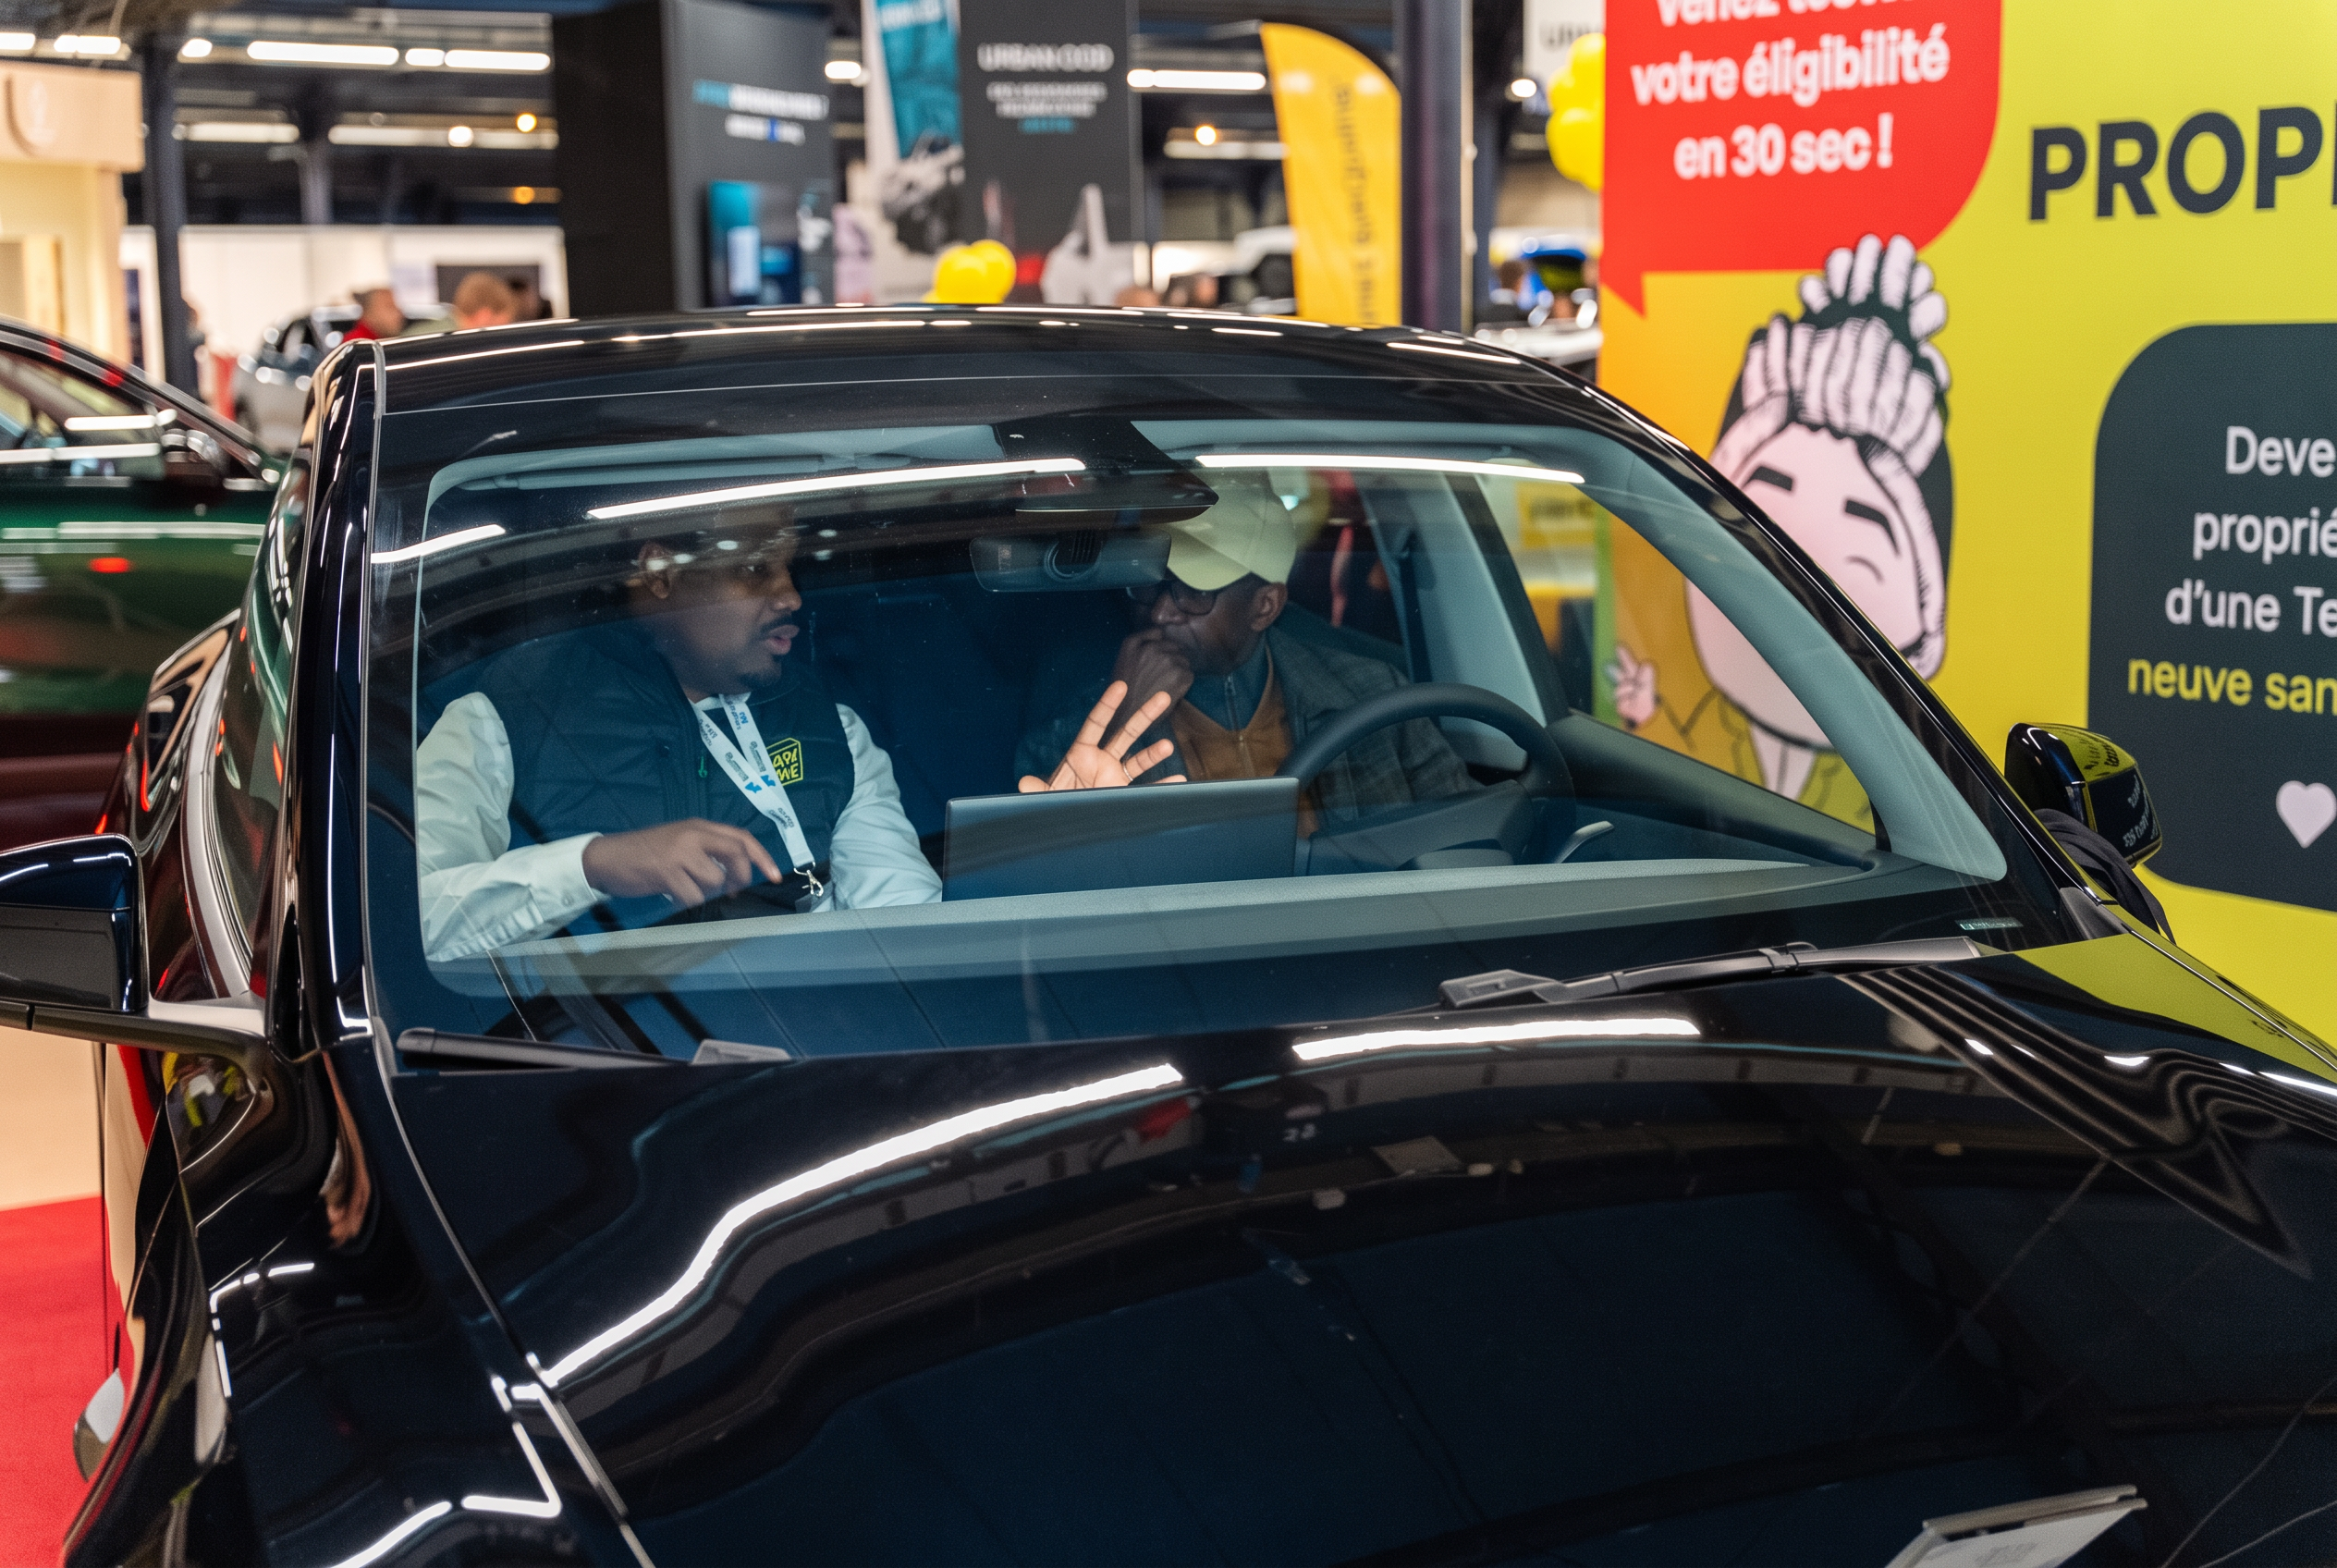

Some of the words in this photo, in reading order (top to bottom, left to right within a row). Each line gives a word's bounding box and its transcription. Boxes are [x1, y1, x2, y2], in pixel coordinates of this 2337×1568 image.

[1631, 51, 1739, 104] votre
[1743, 23, 1950, 106] éligibilité
[1674, 136, 1726, 179] en
[1731, 123, 1786, 178] 30
[1791, 127, 1872, 174] sec
[2028, 100, 2337, 223] PROP
[2226, 425, 2336, 478] Deve
[2194, 507, 2337, 565] proprié
[2165, 578, 2281, 632] d'une
[2293, 585, 2337, 638] Te
[2128, 659, 2253, 706] neuve
[2265, 672, 2337, 717] san
